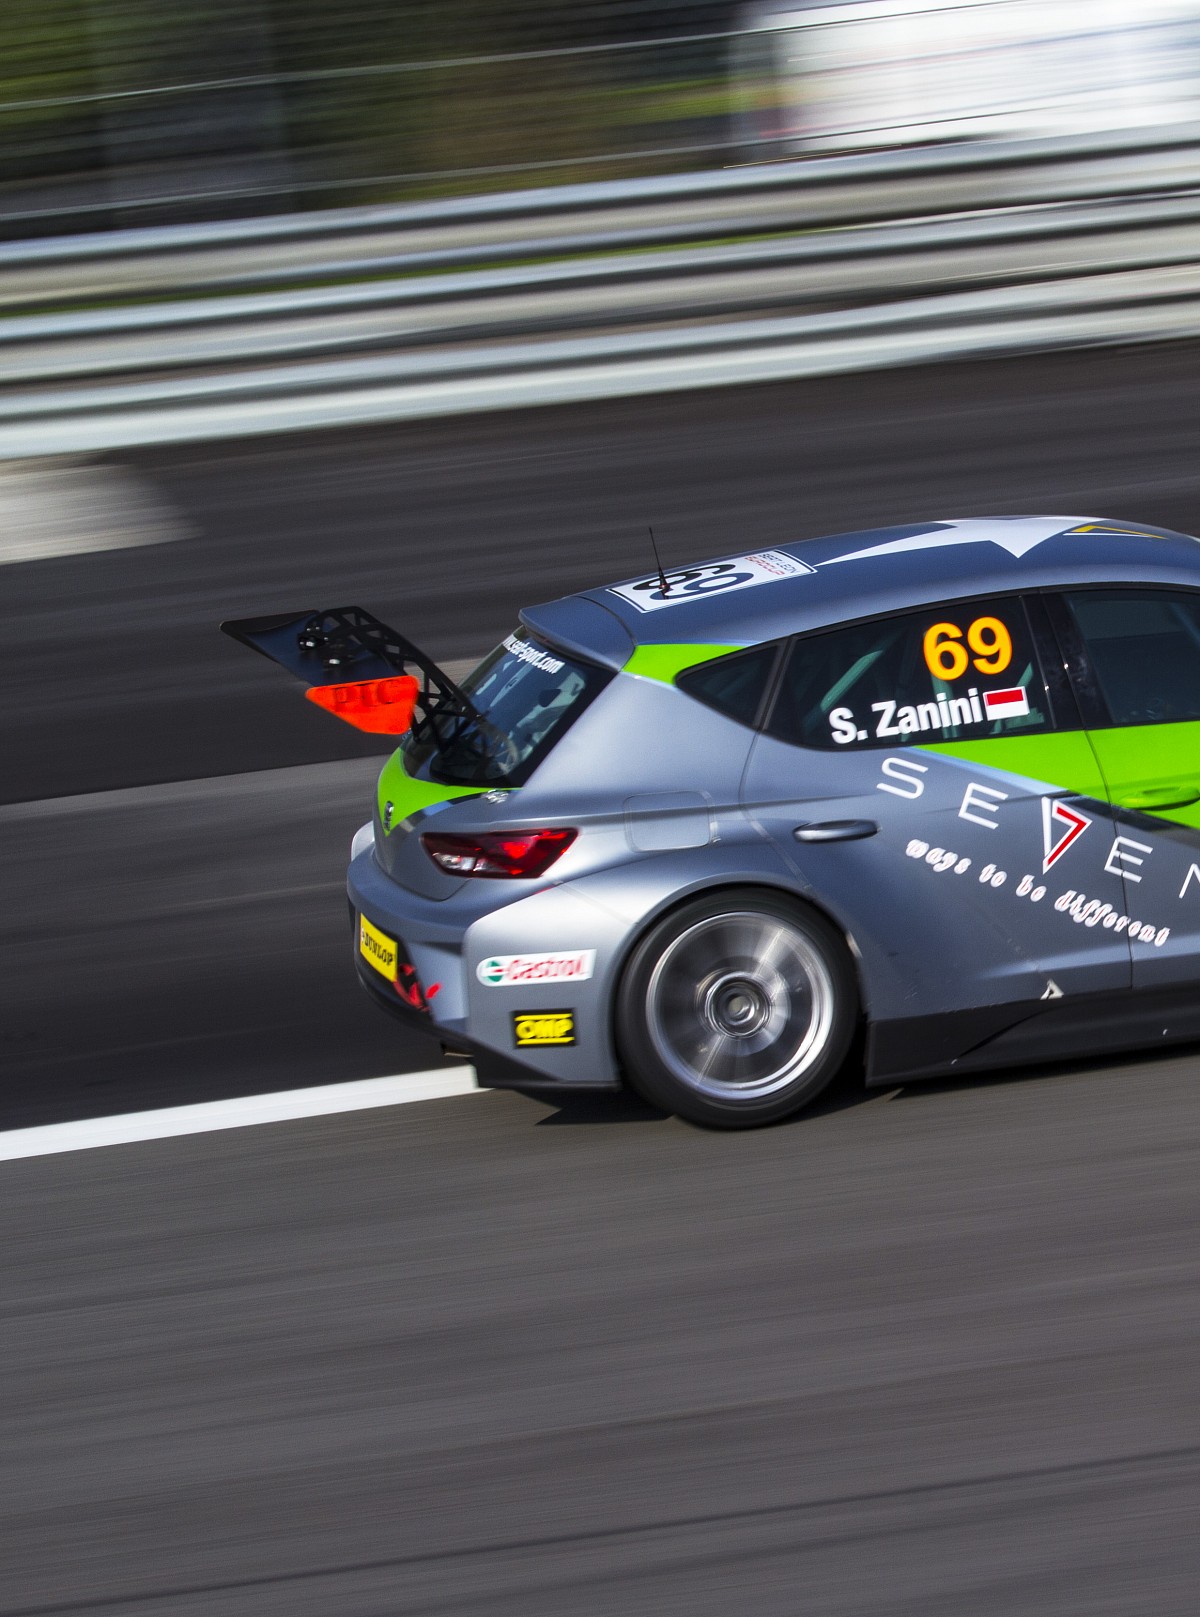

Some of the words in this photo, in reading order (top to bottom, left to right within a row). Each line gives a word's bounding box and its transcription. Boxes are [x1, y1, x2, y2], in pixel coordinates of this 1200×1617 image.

[923, 616, 1013, 681] 69
[829, 707, 868, 744] S.
[872, 688, 983, 738] Zanini
[905, 839, 972, 873] ways
[978, 863, 1007, 888] to
[1015, 874, 1047, 902] be
[1054, 889, 1171, 947] different
[365, 932, 394, 966] DUNLOP
[504, 954, 588, 980] Castrol
[516, 1017, 574, 1039] OMP
